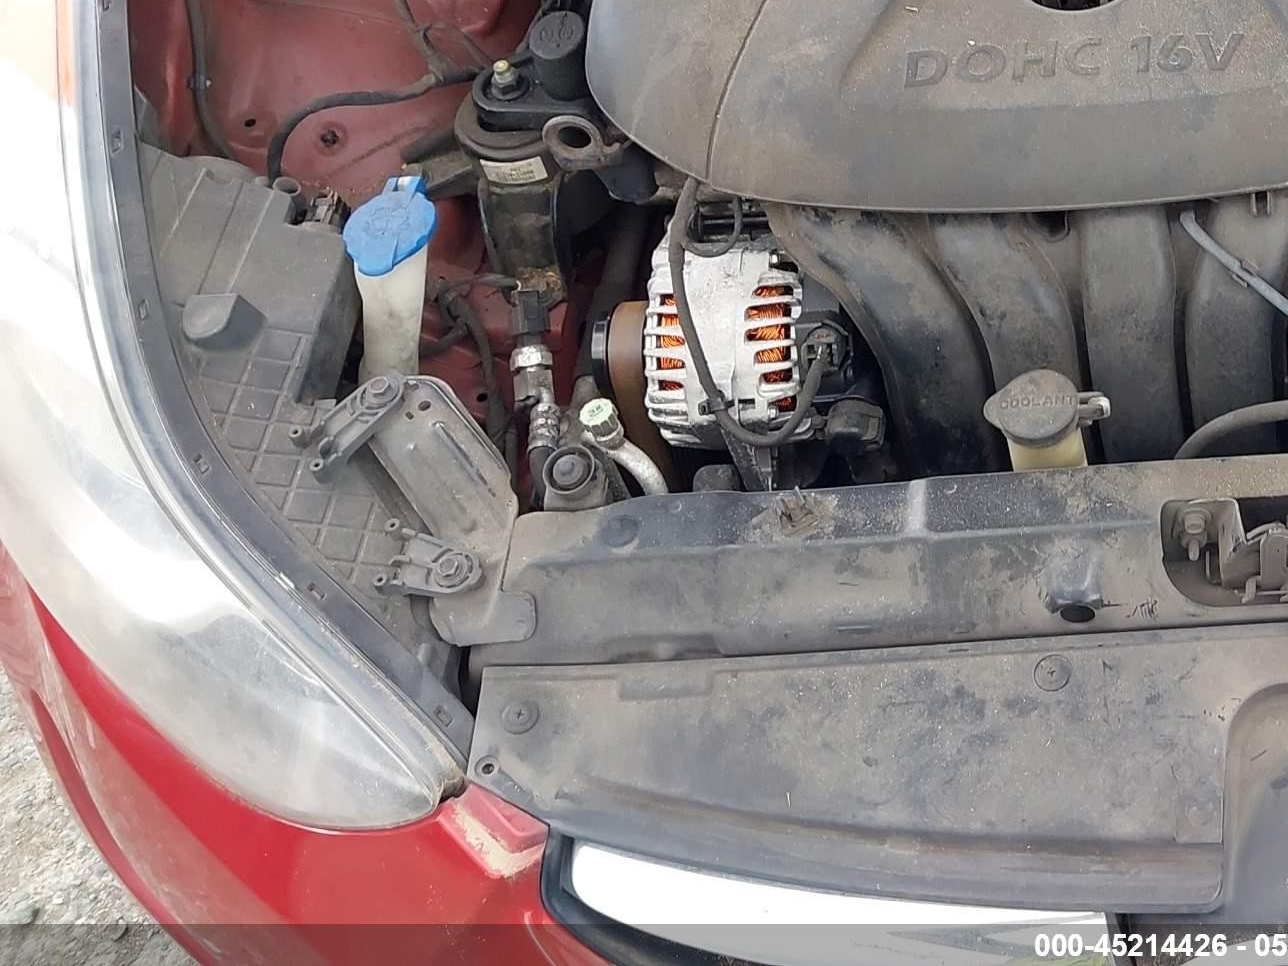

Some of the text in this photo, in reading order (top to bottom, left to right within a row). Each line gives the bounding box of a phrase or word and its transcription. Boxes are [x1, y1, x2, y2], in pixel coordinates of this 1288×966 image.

[903, 32, 1245, 88] DOHC 16V
[1000, 394, 1074, 410] COOLANT
